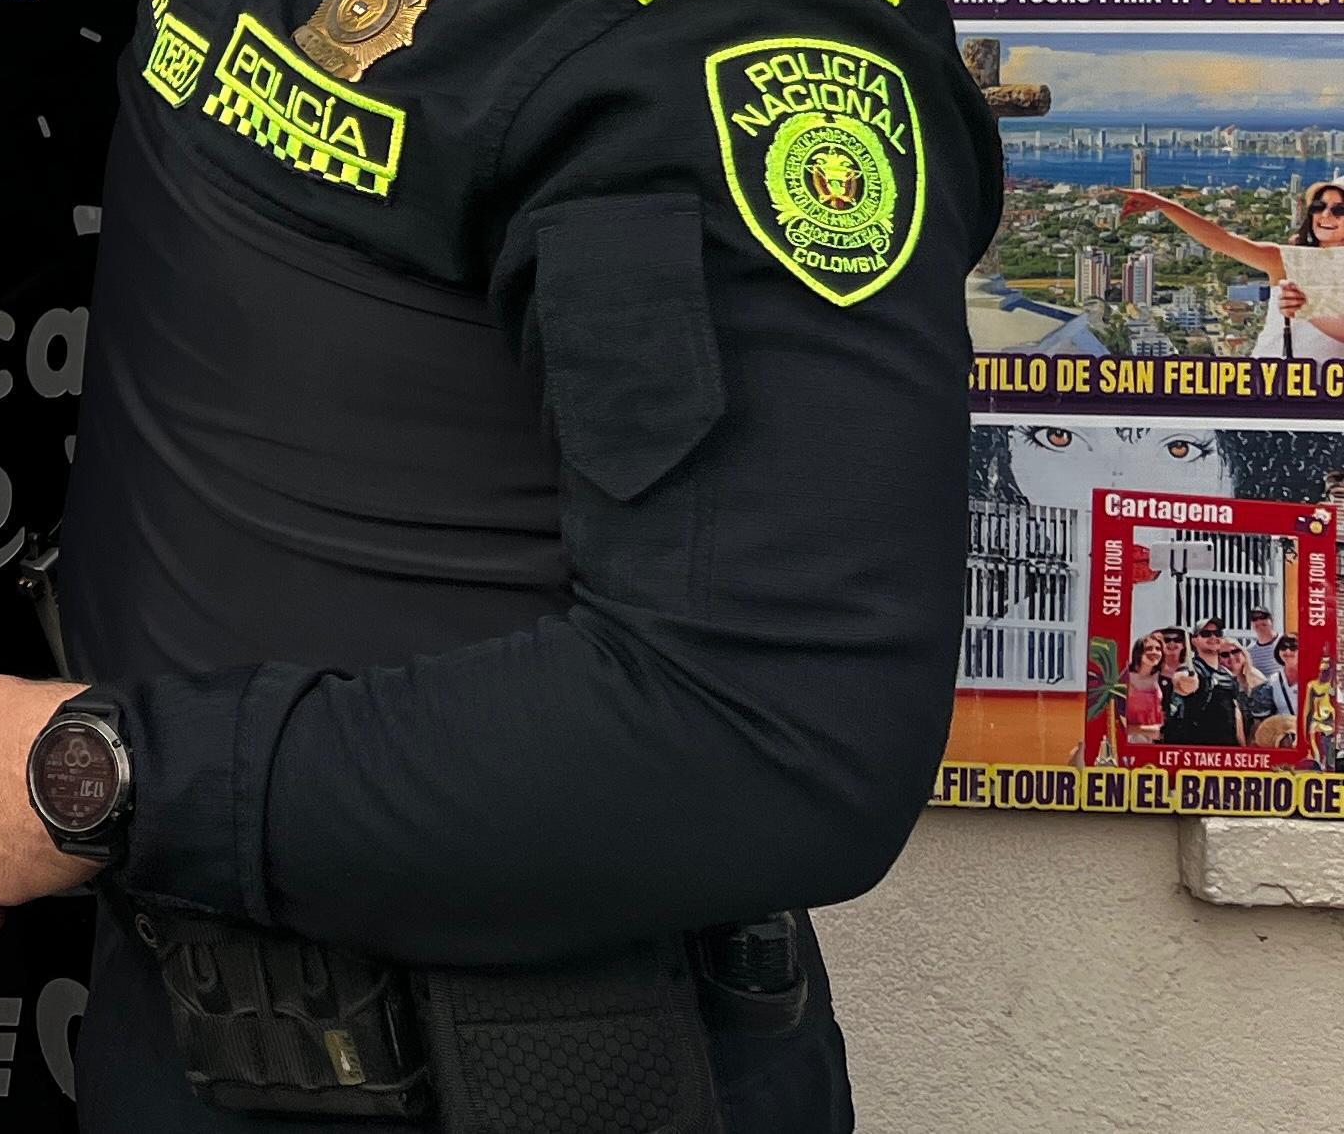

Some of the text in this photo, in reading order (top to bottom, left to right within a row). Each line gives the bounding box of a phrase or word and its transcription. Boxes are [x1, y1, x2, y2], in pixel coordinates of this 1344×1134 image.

[232, 44, 367, 158] POLICÍA
[731, 84, 906, 154] NACIONAL
[792, 248, 889, 273] COLOMBIA
[969, 359, 1047, 393] TILLO
[1057, 359, 1090, 393] DE
[1099, 360, 1154, 393] SAN
[1164, 362, 1252, 395] FELIPE
[1260, 363, 1277, 396] Y
[1287, 364, 1317, 396] EL
[1105, 493, 1233, 524] Cartagena
[1103, 539, 1123, 616] SELFIE TOUR
[1309, 552, 1326, 628] SELFIE TOUR
[1194, 752, 1223, 767] TAKE
[1224, 753, 1232, 767] A
[1234, 754, 1270, 769] SELFIE
[933, 766, 987, 803] FIE
[995, 769, 1077, 806] TOUR
[1087, 771, 1127, 808] EN
[1140, 773, 1171, 809] EL
[1181, 775, 1293, 812] BARRIO
